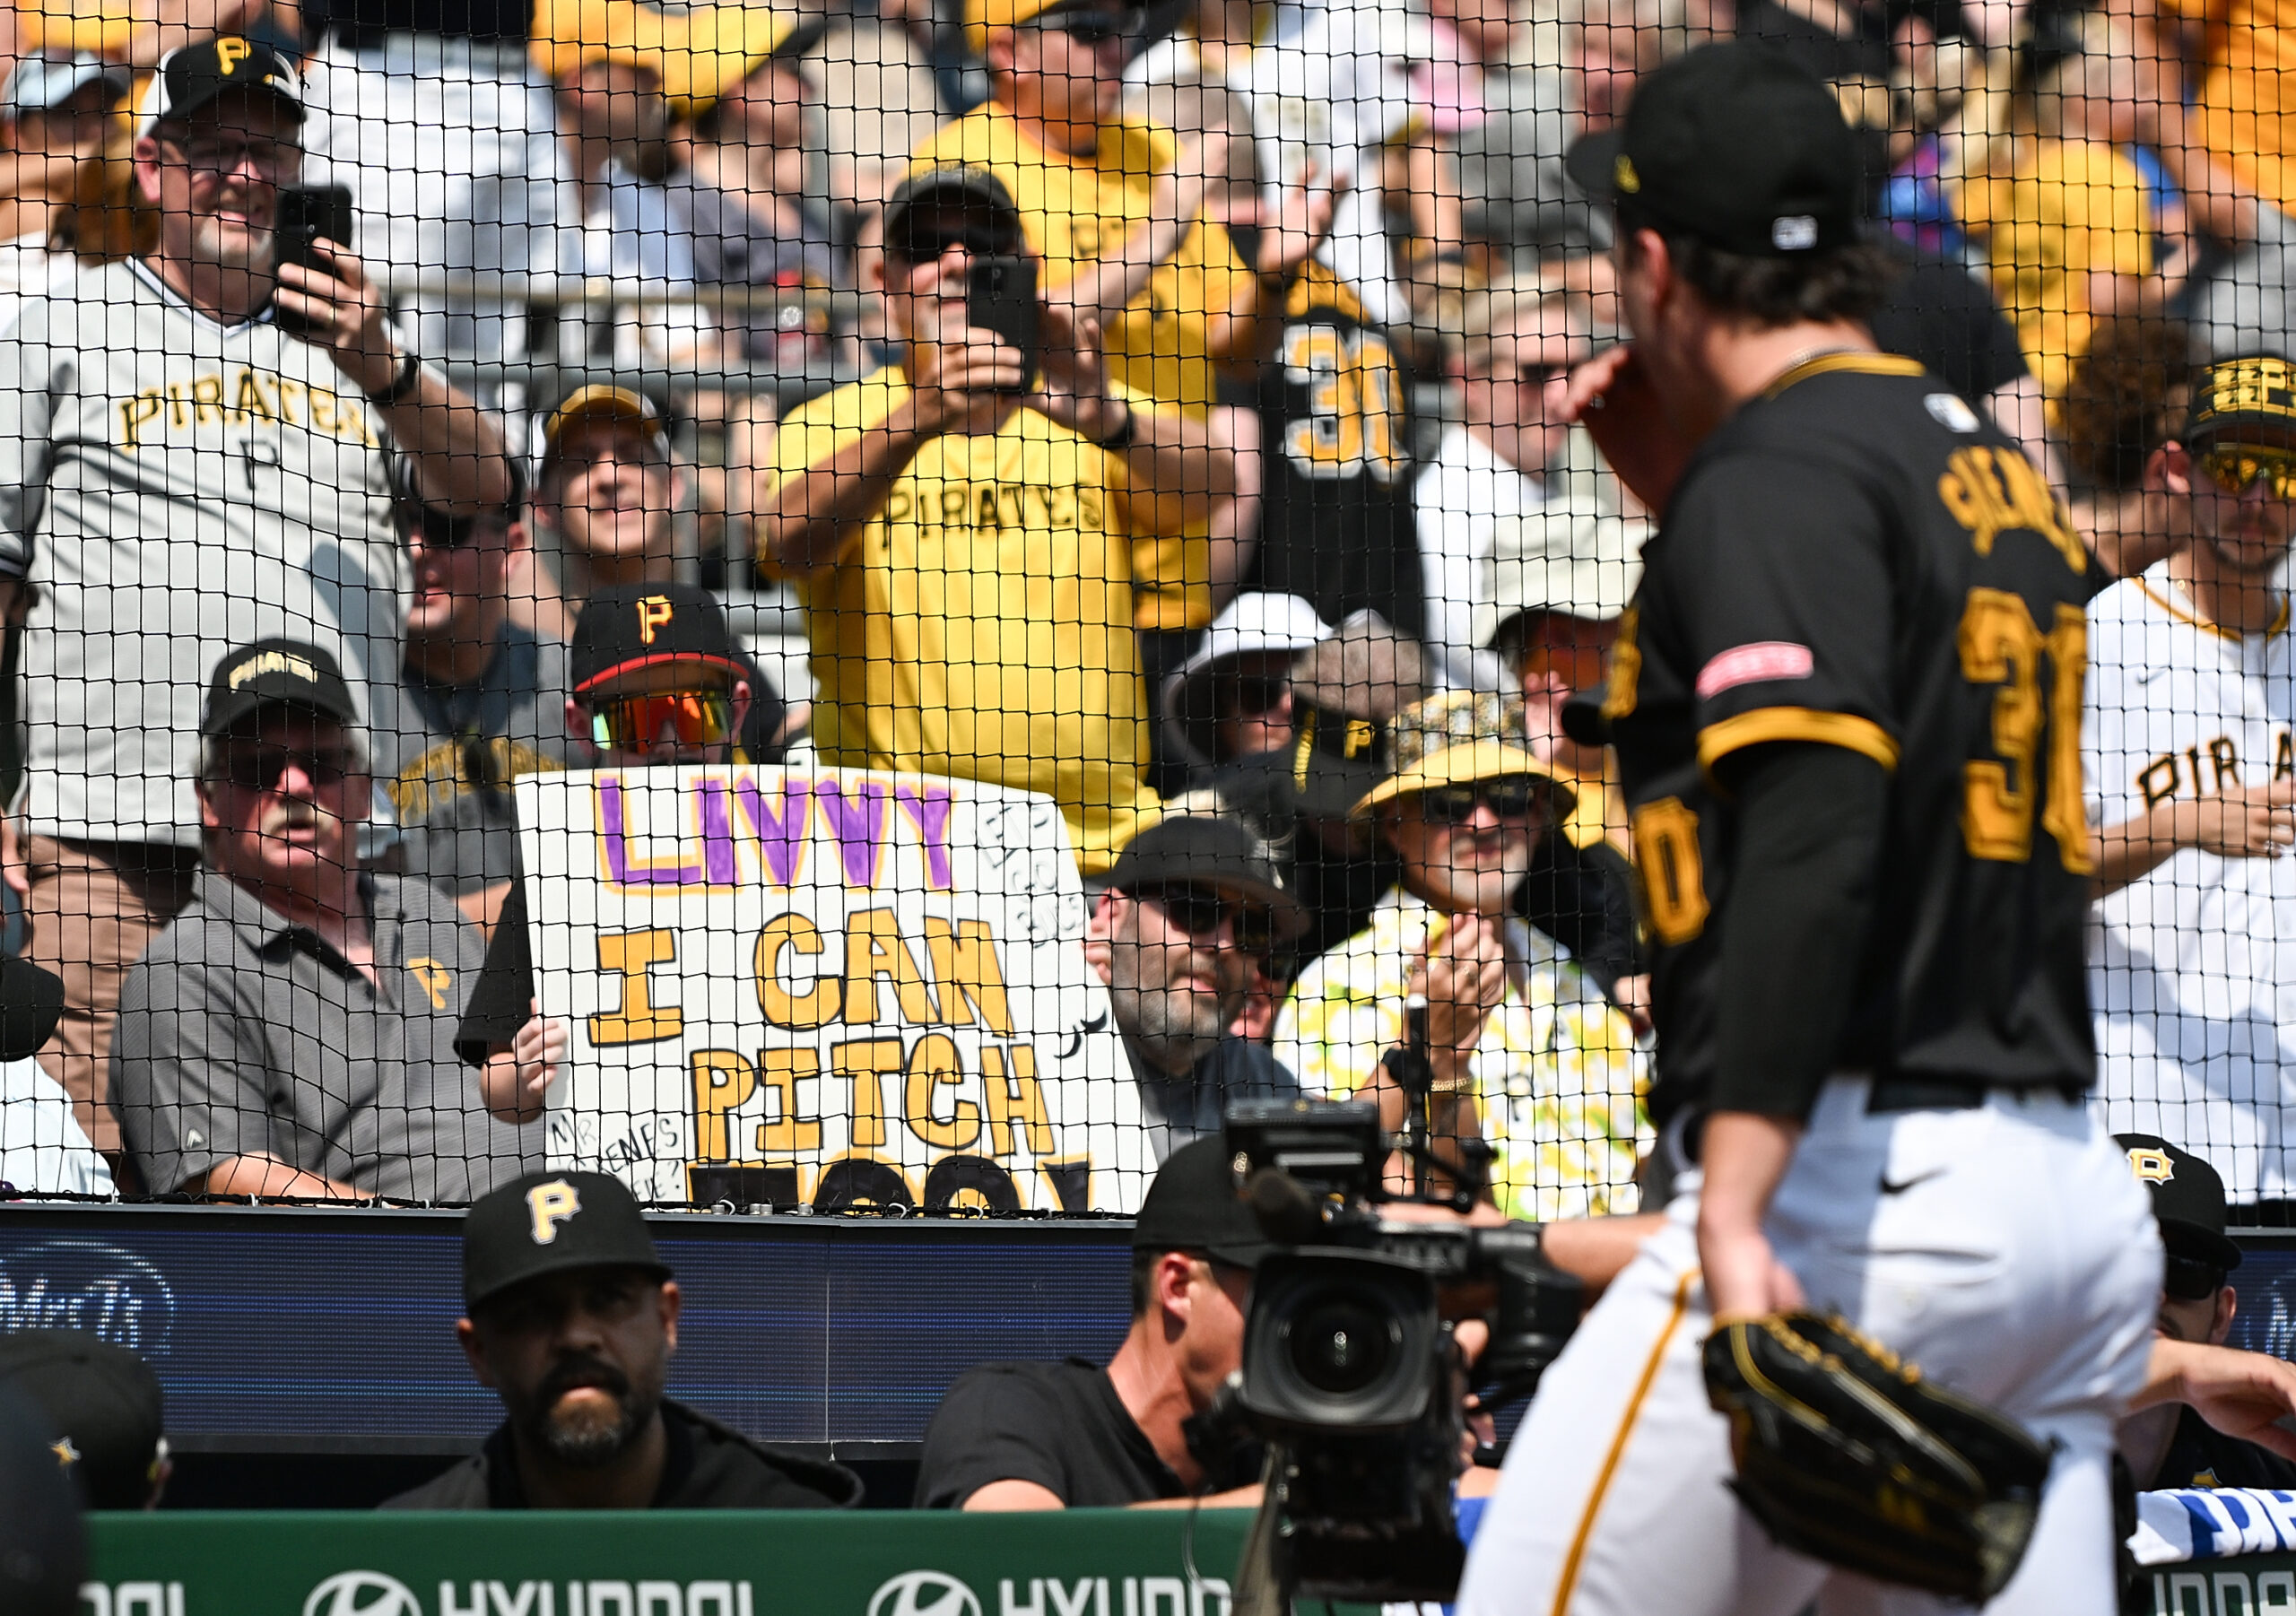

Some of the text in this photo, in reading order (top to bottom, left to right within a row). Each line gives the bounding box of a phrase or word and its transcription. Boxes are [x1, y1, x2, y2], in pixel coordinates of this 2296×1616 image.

[213, 37, 252, 76] P
[635, 594, 674, 646] P
[592, 769, 958, 896] LIVVY
[406, 956, 453, 1010] P
[587, 906, 1017, 1047] I CAN
[690, 1032, 1057, 1165] PITCH
[551, 1113, 597, 1167] MR
[524, 1177, 583, 1246] P
